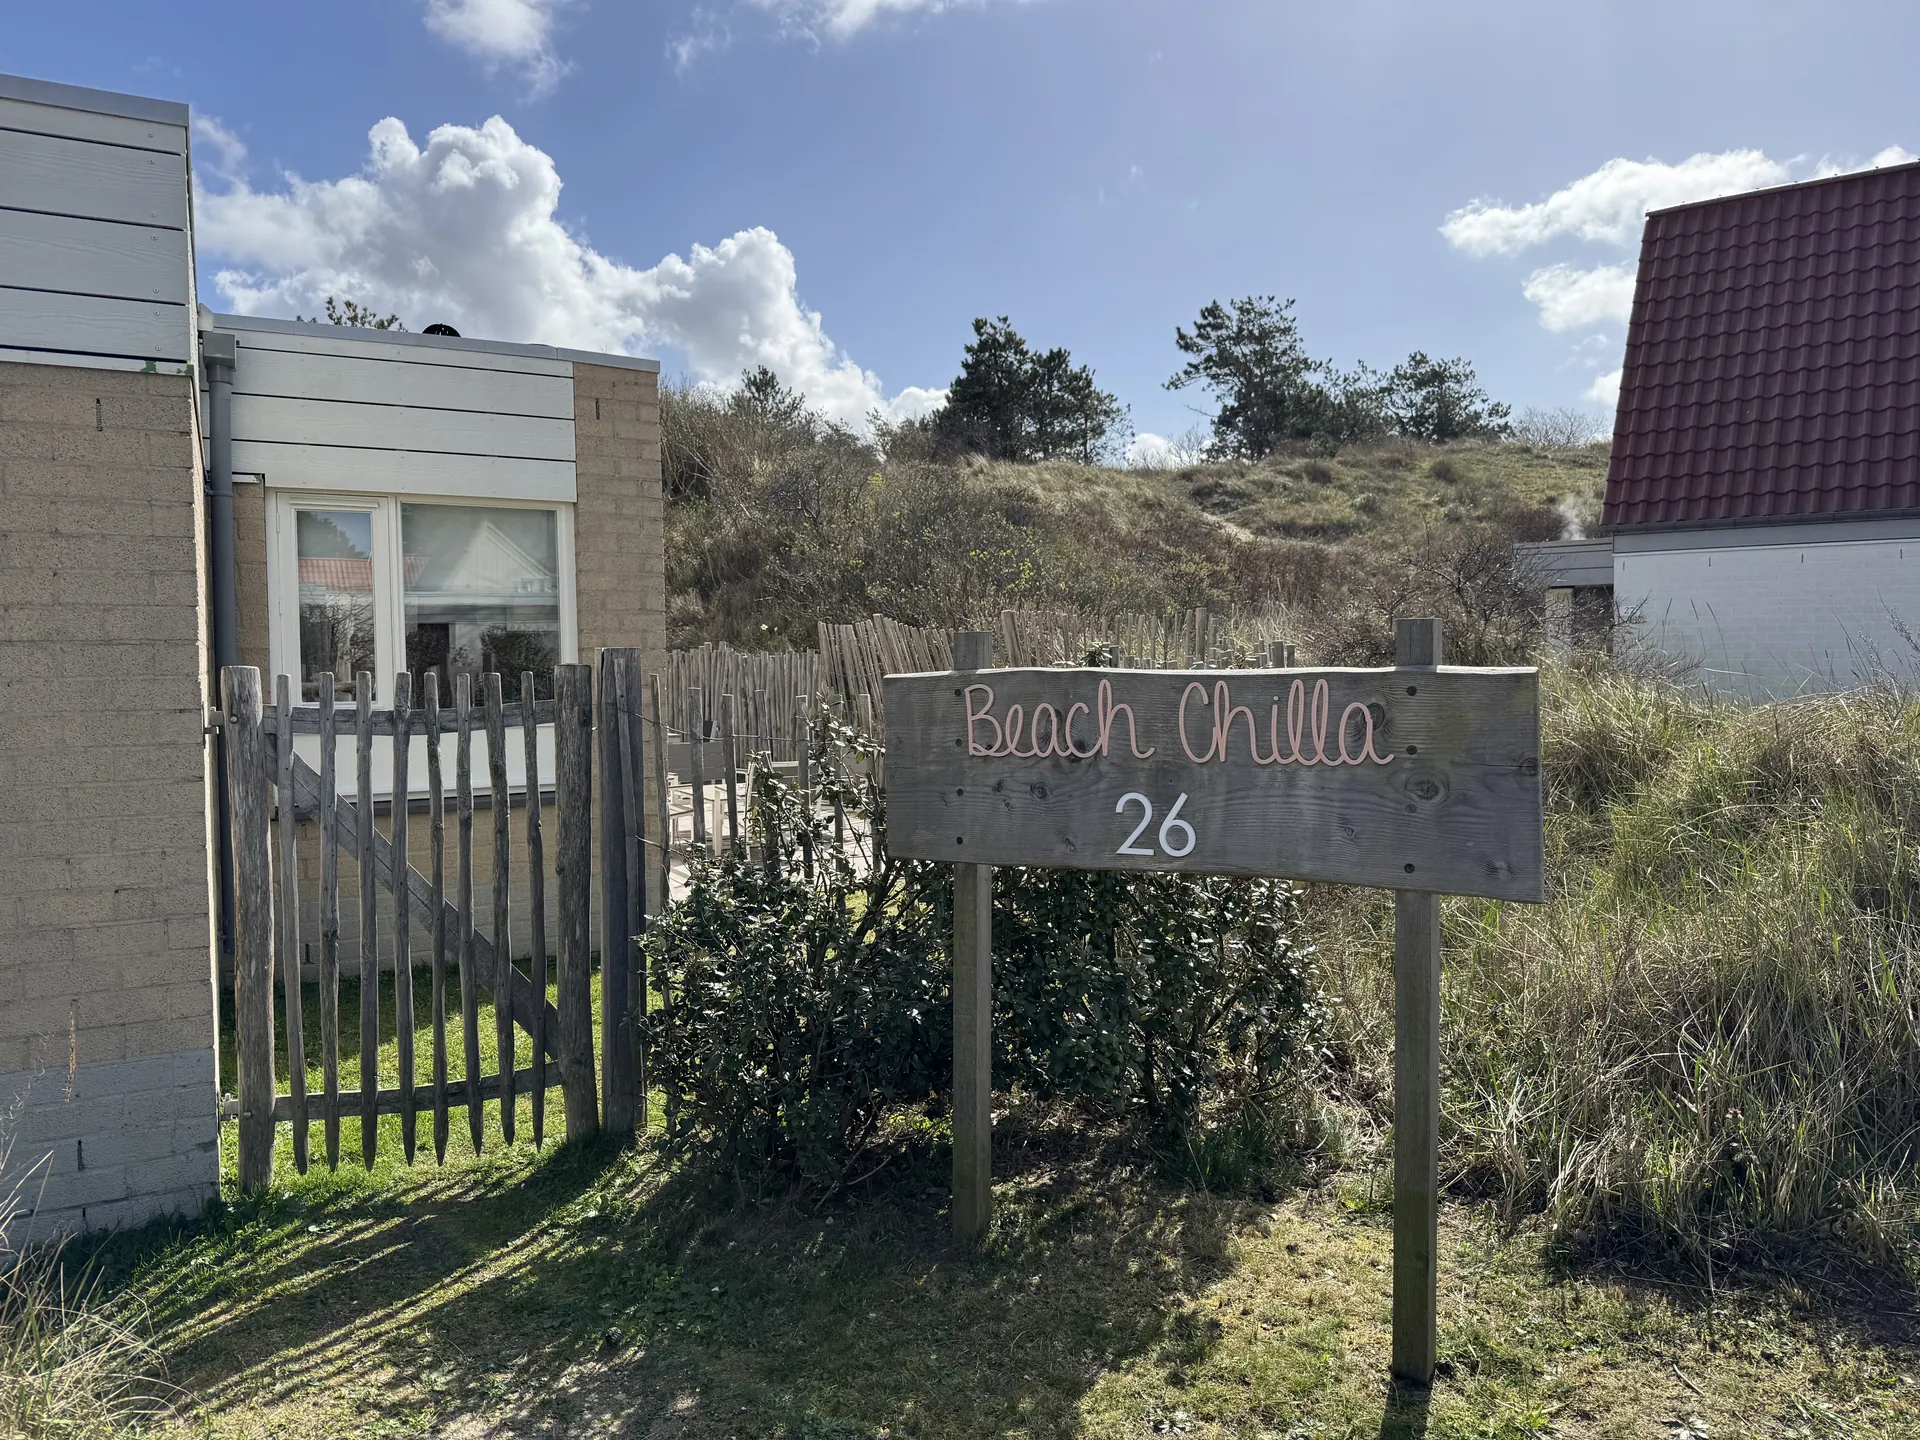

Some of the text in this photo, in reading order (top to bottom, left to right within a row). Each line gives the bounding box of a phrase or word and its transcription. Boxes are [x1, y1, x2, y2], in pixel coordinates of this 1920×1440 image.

[965, 678, 1394, 767] Beach Chilla
[1115, 792, 1197, 858] 26
